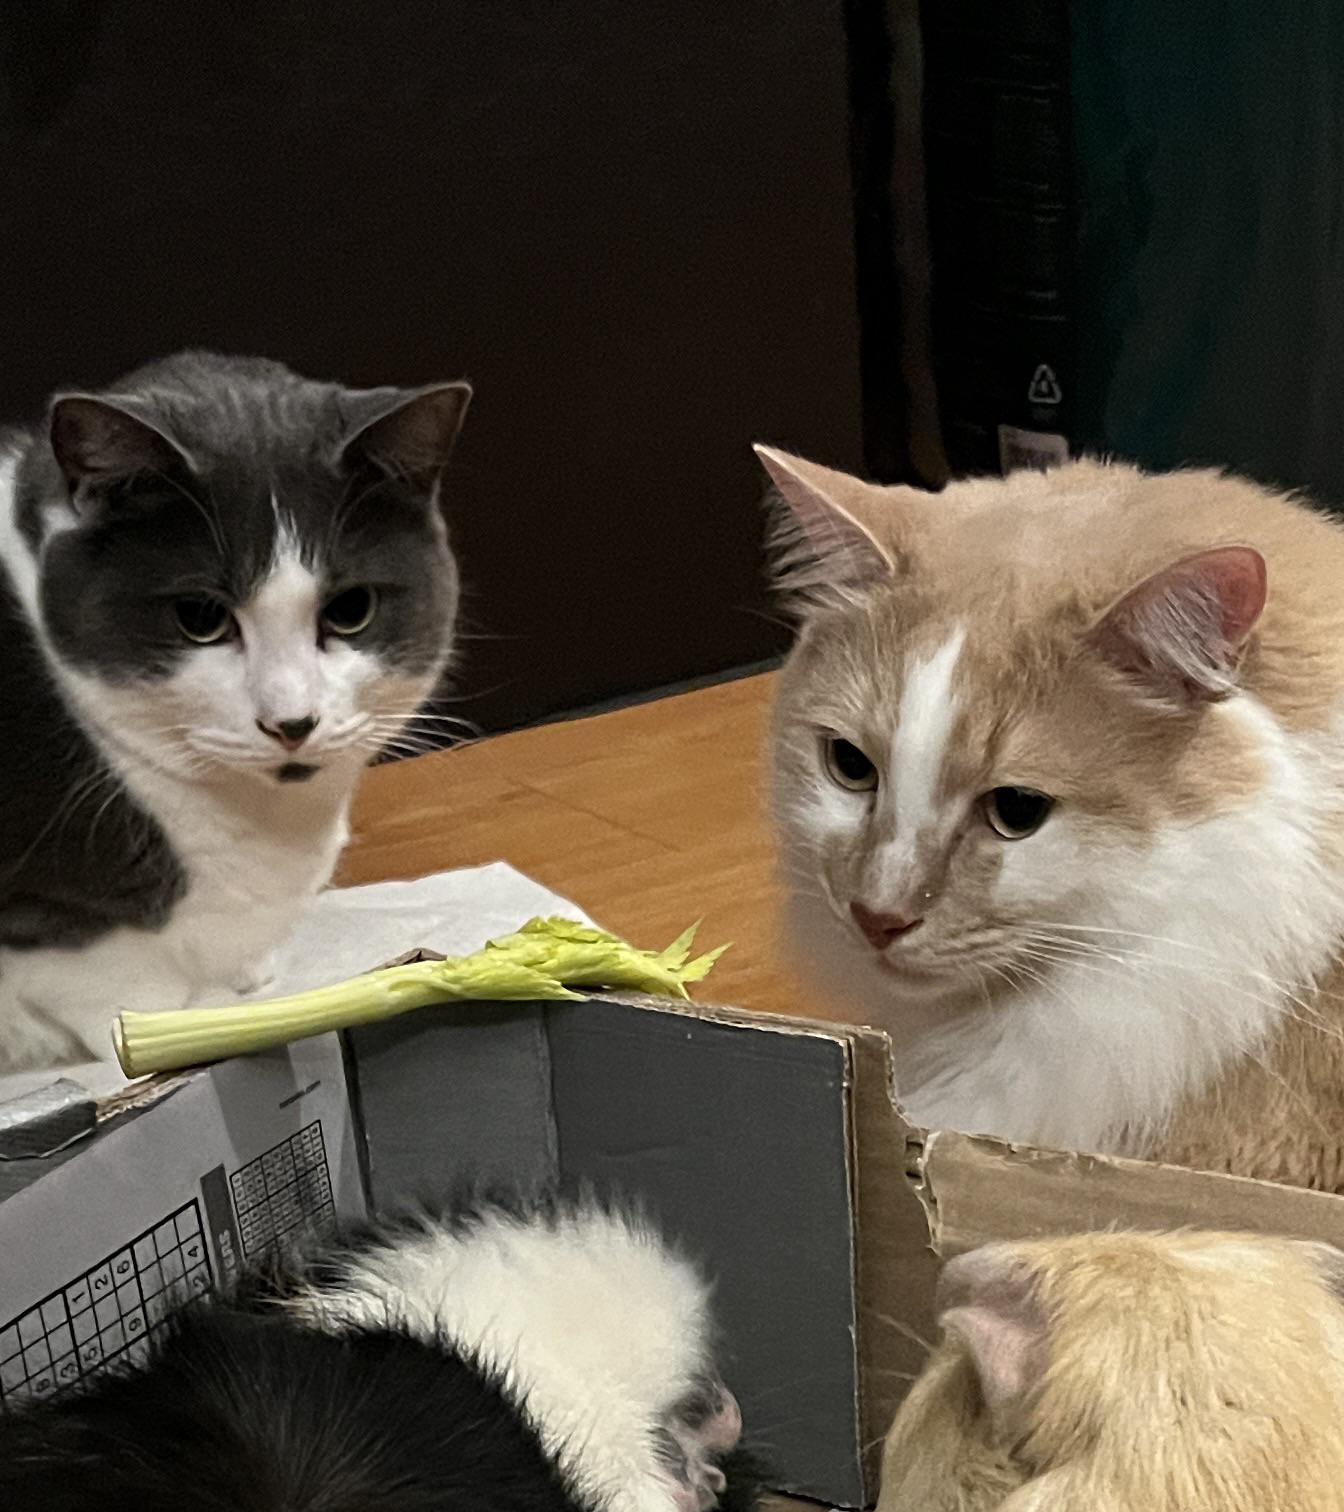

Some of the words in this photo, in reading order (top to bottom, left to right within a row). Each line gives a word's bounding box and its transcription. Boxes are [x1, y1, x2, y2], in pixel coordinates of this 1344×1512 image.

[185, 1244, 202, 1260] 4
[114, 1258, 132, 1275] 6
[92, 1274, 110, 1291] 2
[70, 1291, 86, 1304] 1
